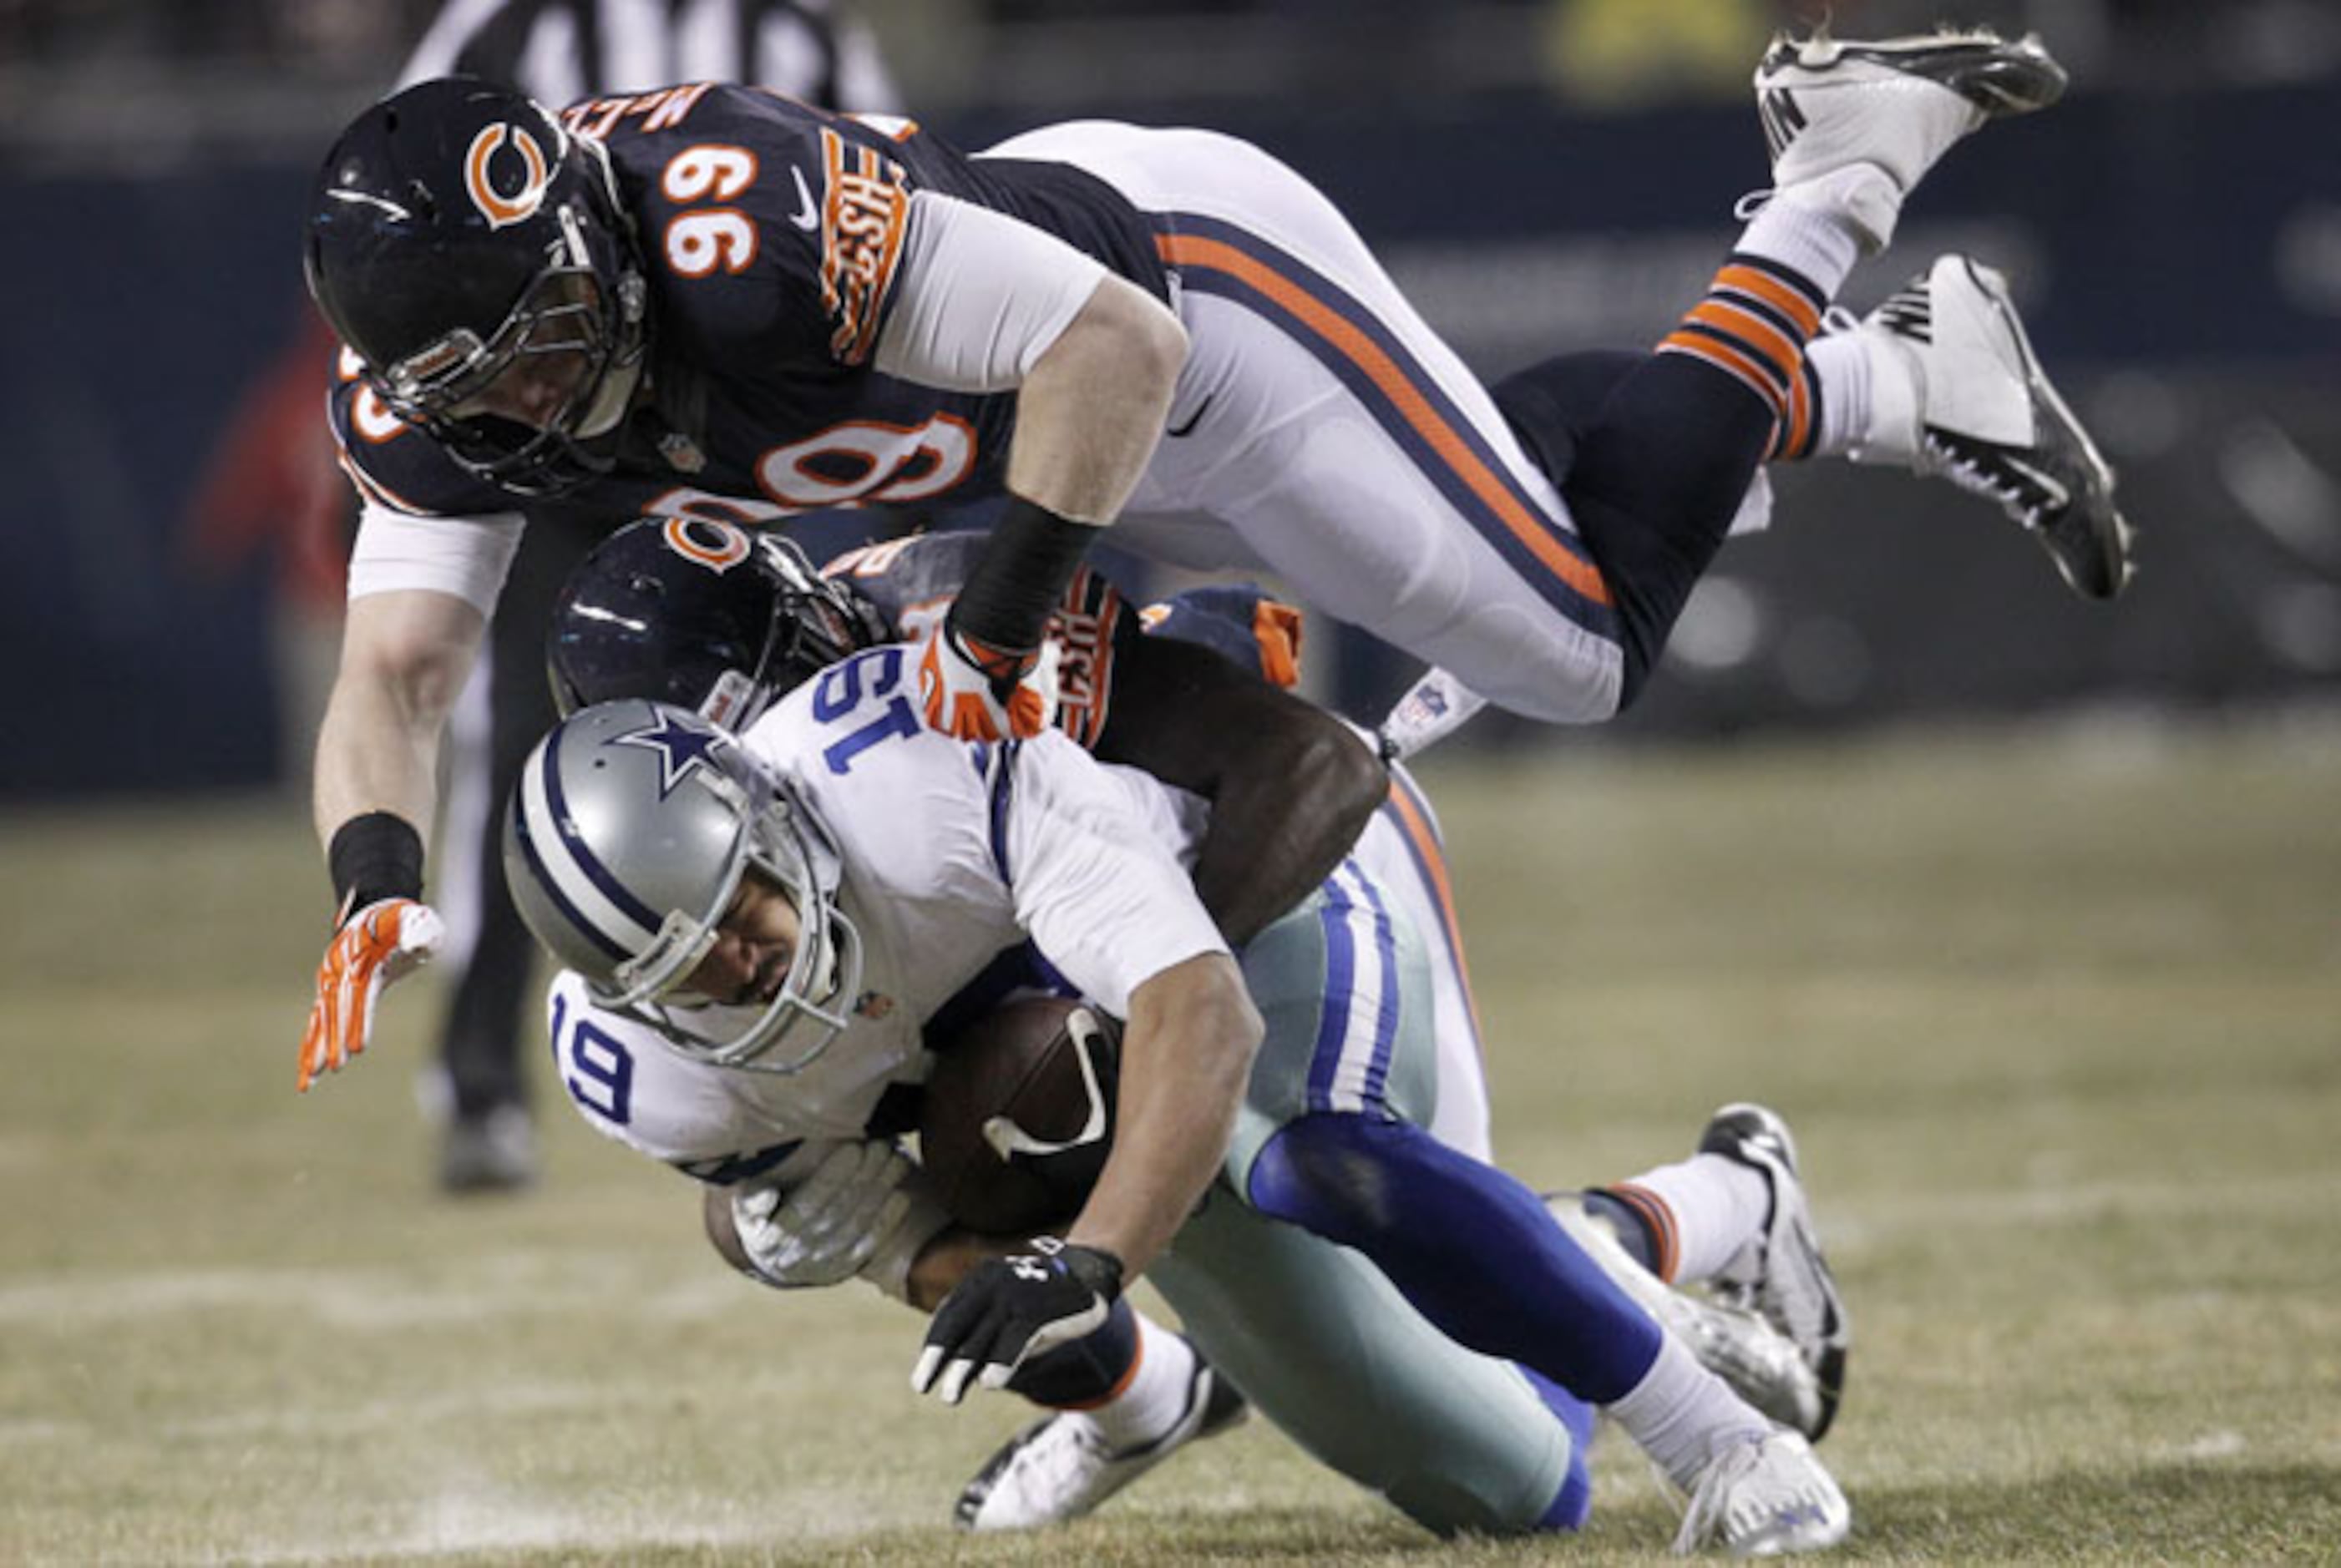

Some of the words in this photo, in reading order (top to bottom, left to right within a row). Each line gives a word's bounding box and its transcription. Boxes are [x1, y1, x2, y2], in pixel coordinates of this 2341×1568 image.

[658, 143, 761, 281] 99
[813, 648, 922, 776] 19
[551, 991, 635, 1125] 19
